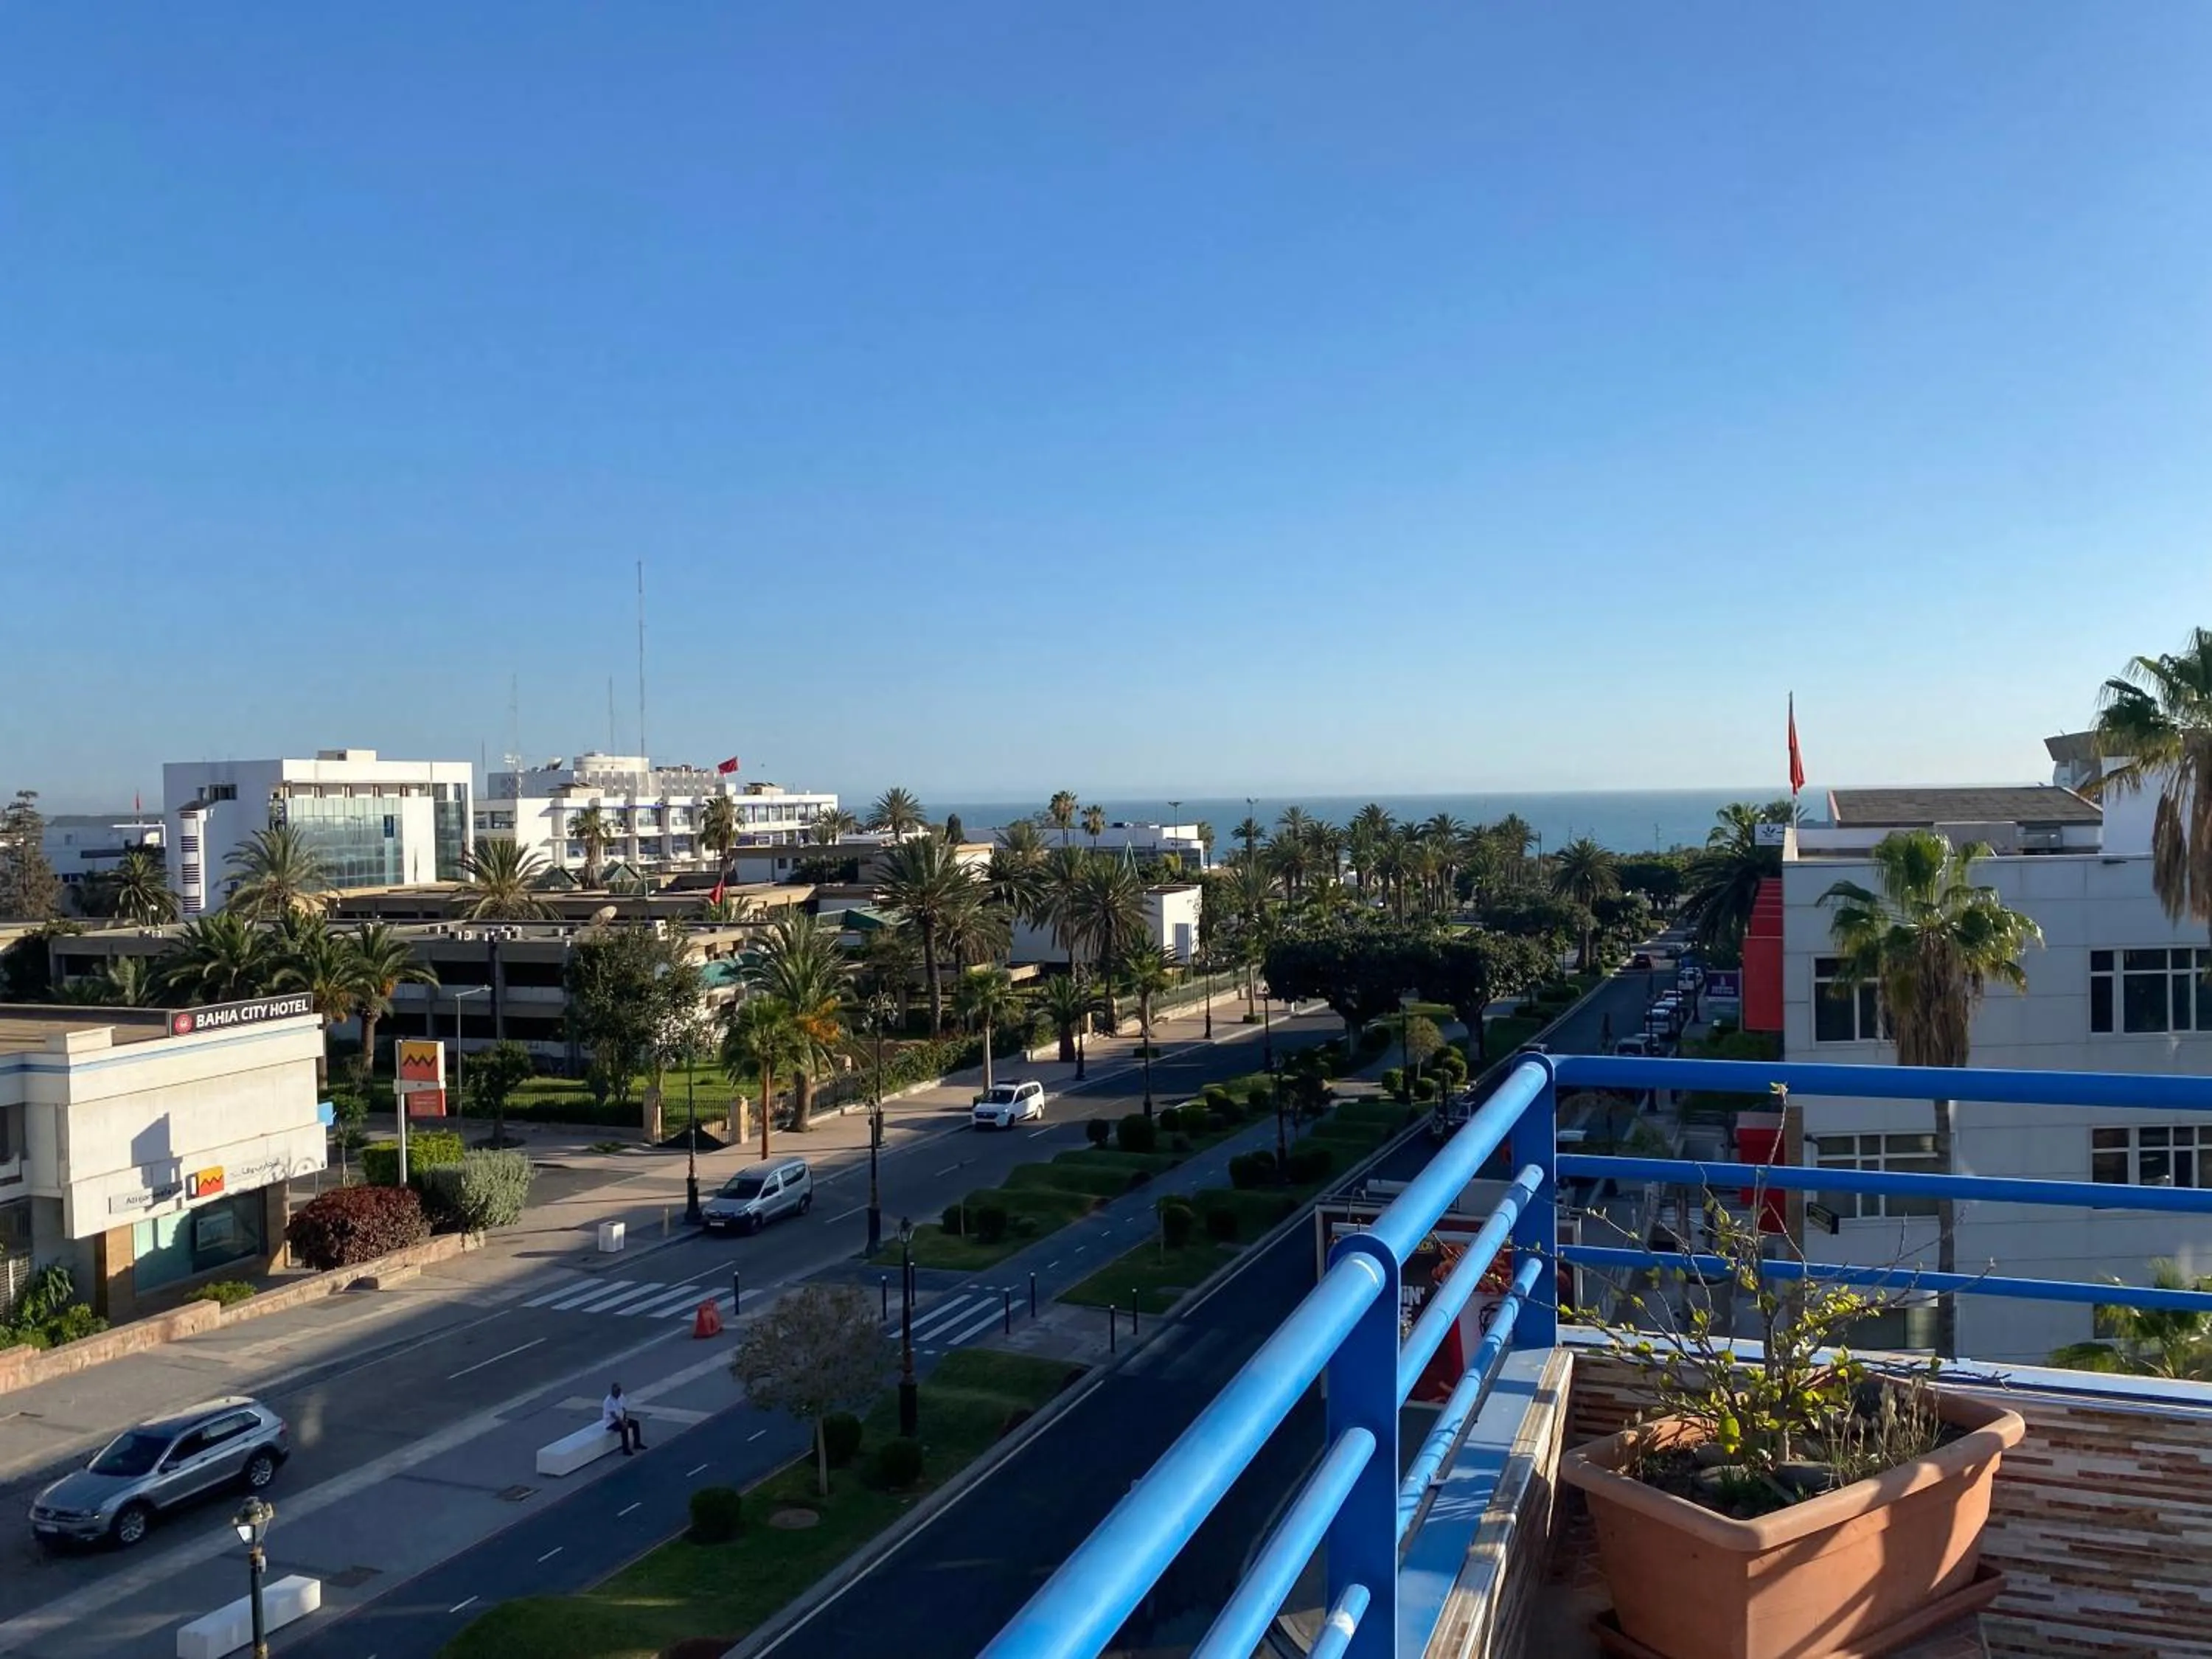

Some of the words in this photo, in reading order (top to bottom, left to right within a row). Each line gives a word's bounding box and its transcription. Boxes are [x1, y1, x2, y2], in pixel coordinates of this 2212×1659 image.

[195, 1009, 238, 1028] BAHIA
[241, 1004, 268, 1020] CITY
[269, 998, 309, 1017] HOTEL
